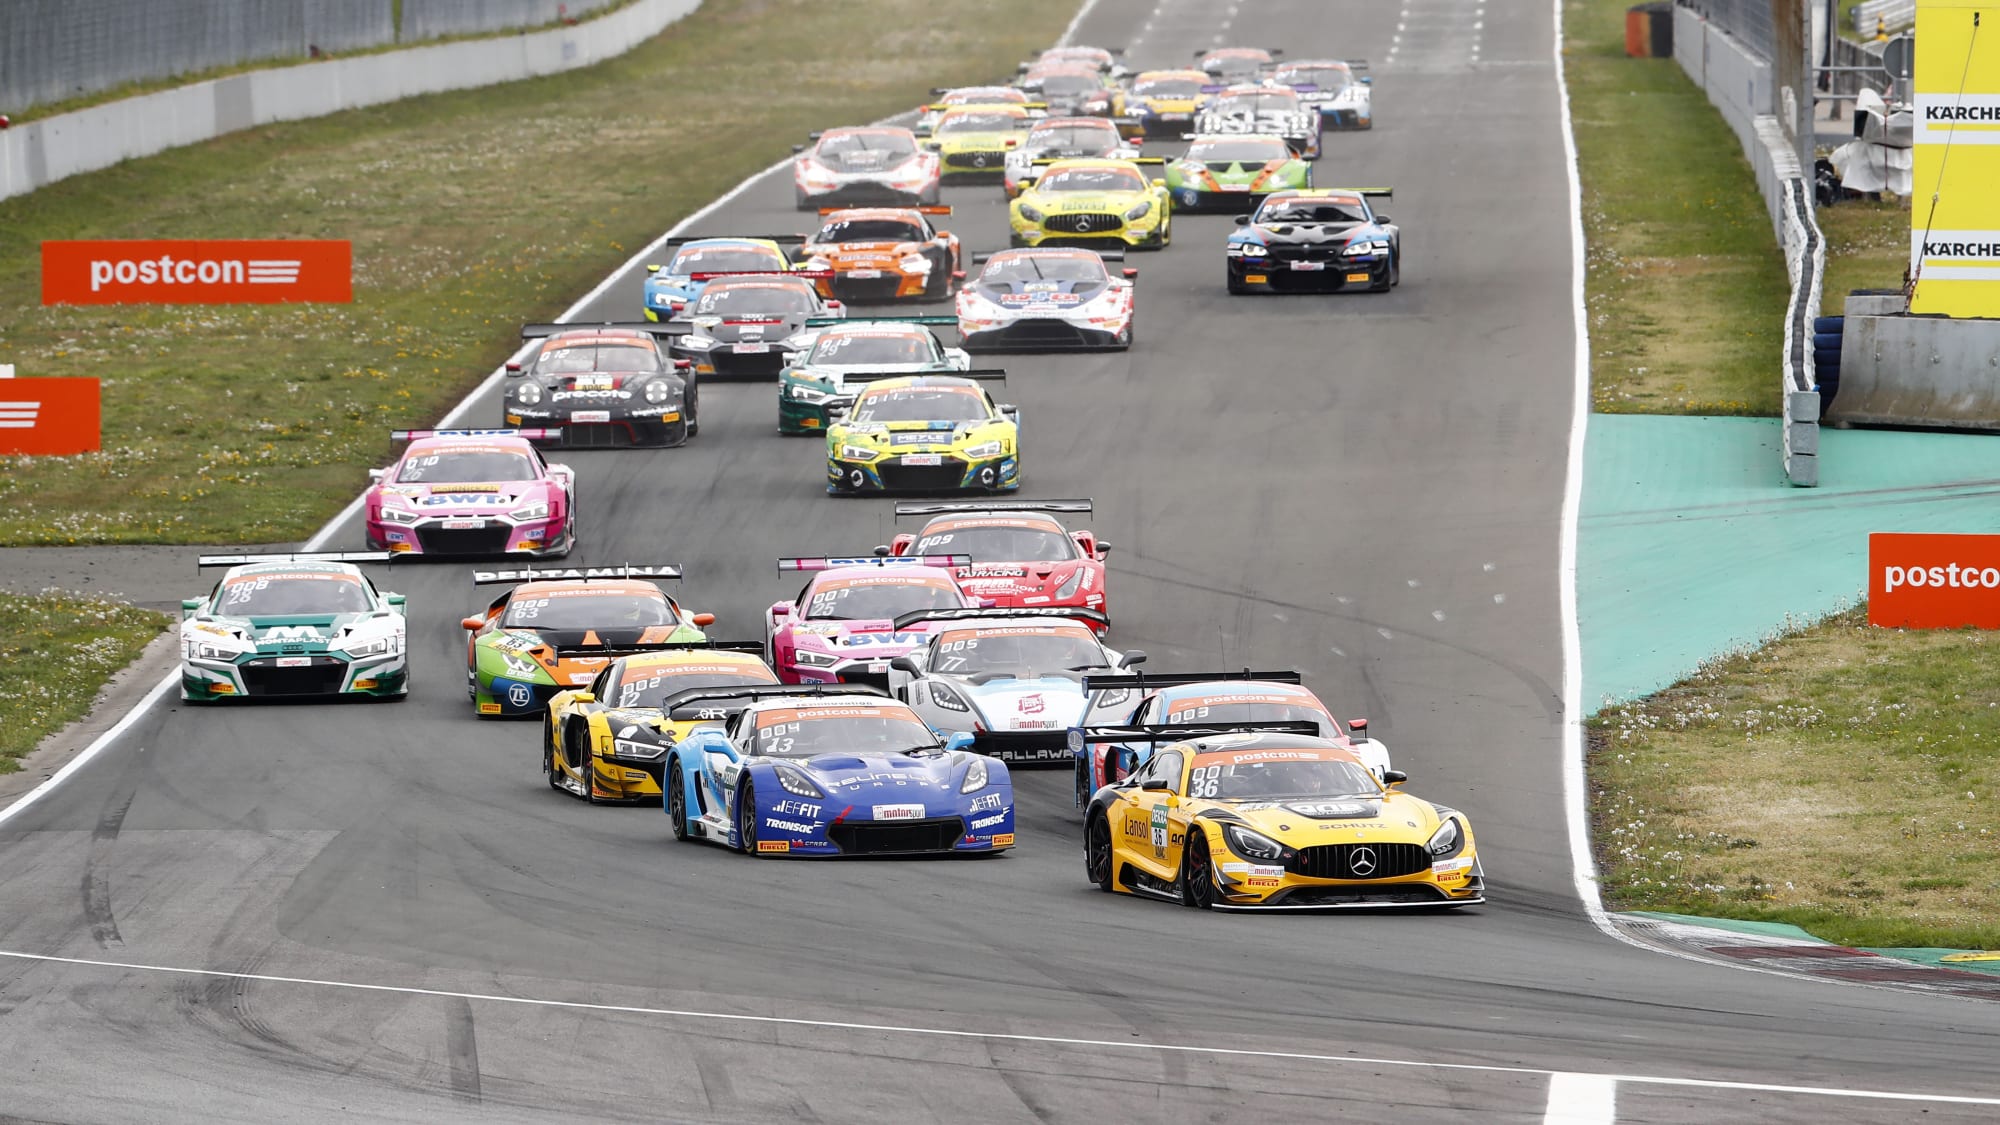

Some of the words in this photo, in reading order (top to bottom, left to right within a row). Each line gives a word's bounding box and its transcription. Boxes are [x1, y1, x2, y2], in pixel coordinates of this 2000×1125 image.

[1924, 242, 2000, 257] KÄRCHE
[91, 255, 244, 292] postcon
[552, 389, 632, 402] precote
[428, 494, 500, 505] BWT
[918, 534, 954, 549] 009
[849, 577, 906, 586] postcon
[1885, 562, 2000, 593] postco
[514, 608, 539, 619] 63
[812, 602, 836, 616] 25
[849, 632, 930, 647] BWT
[976, 628, 1034, 637] postcon
[656, 666, 716, 676] postcon
[939, 656, 967, 672] 77
[623, 677, 661, 696] 002
[619, 692, 641, 708] 12
[1203, 695, 1265, 704] postcon
[796, 709, 860, 719] postcon
[1169, 706, 1209, 725] 003
[760, 722, 800, 740] 004
[766, 737, 795, 753] 13
[989, 749, 1075, 761] CALLAWA
[1233, 752, 1298, 764] postcon
[1191, 779, 1219, 798] 36
[883, 807, 924, 819] motorsport
[1152, 808, 1167, 825] DEKRA
[1125, 814, 1149, 840] Lansol
[1154, 828, 1163, 846] 36
[760, 842, 787, 851] PIRELLI
[1248, 878, 1279, 887] PIRELLI
